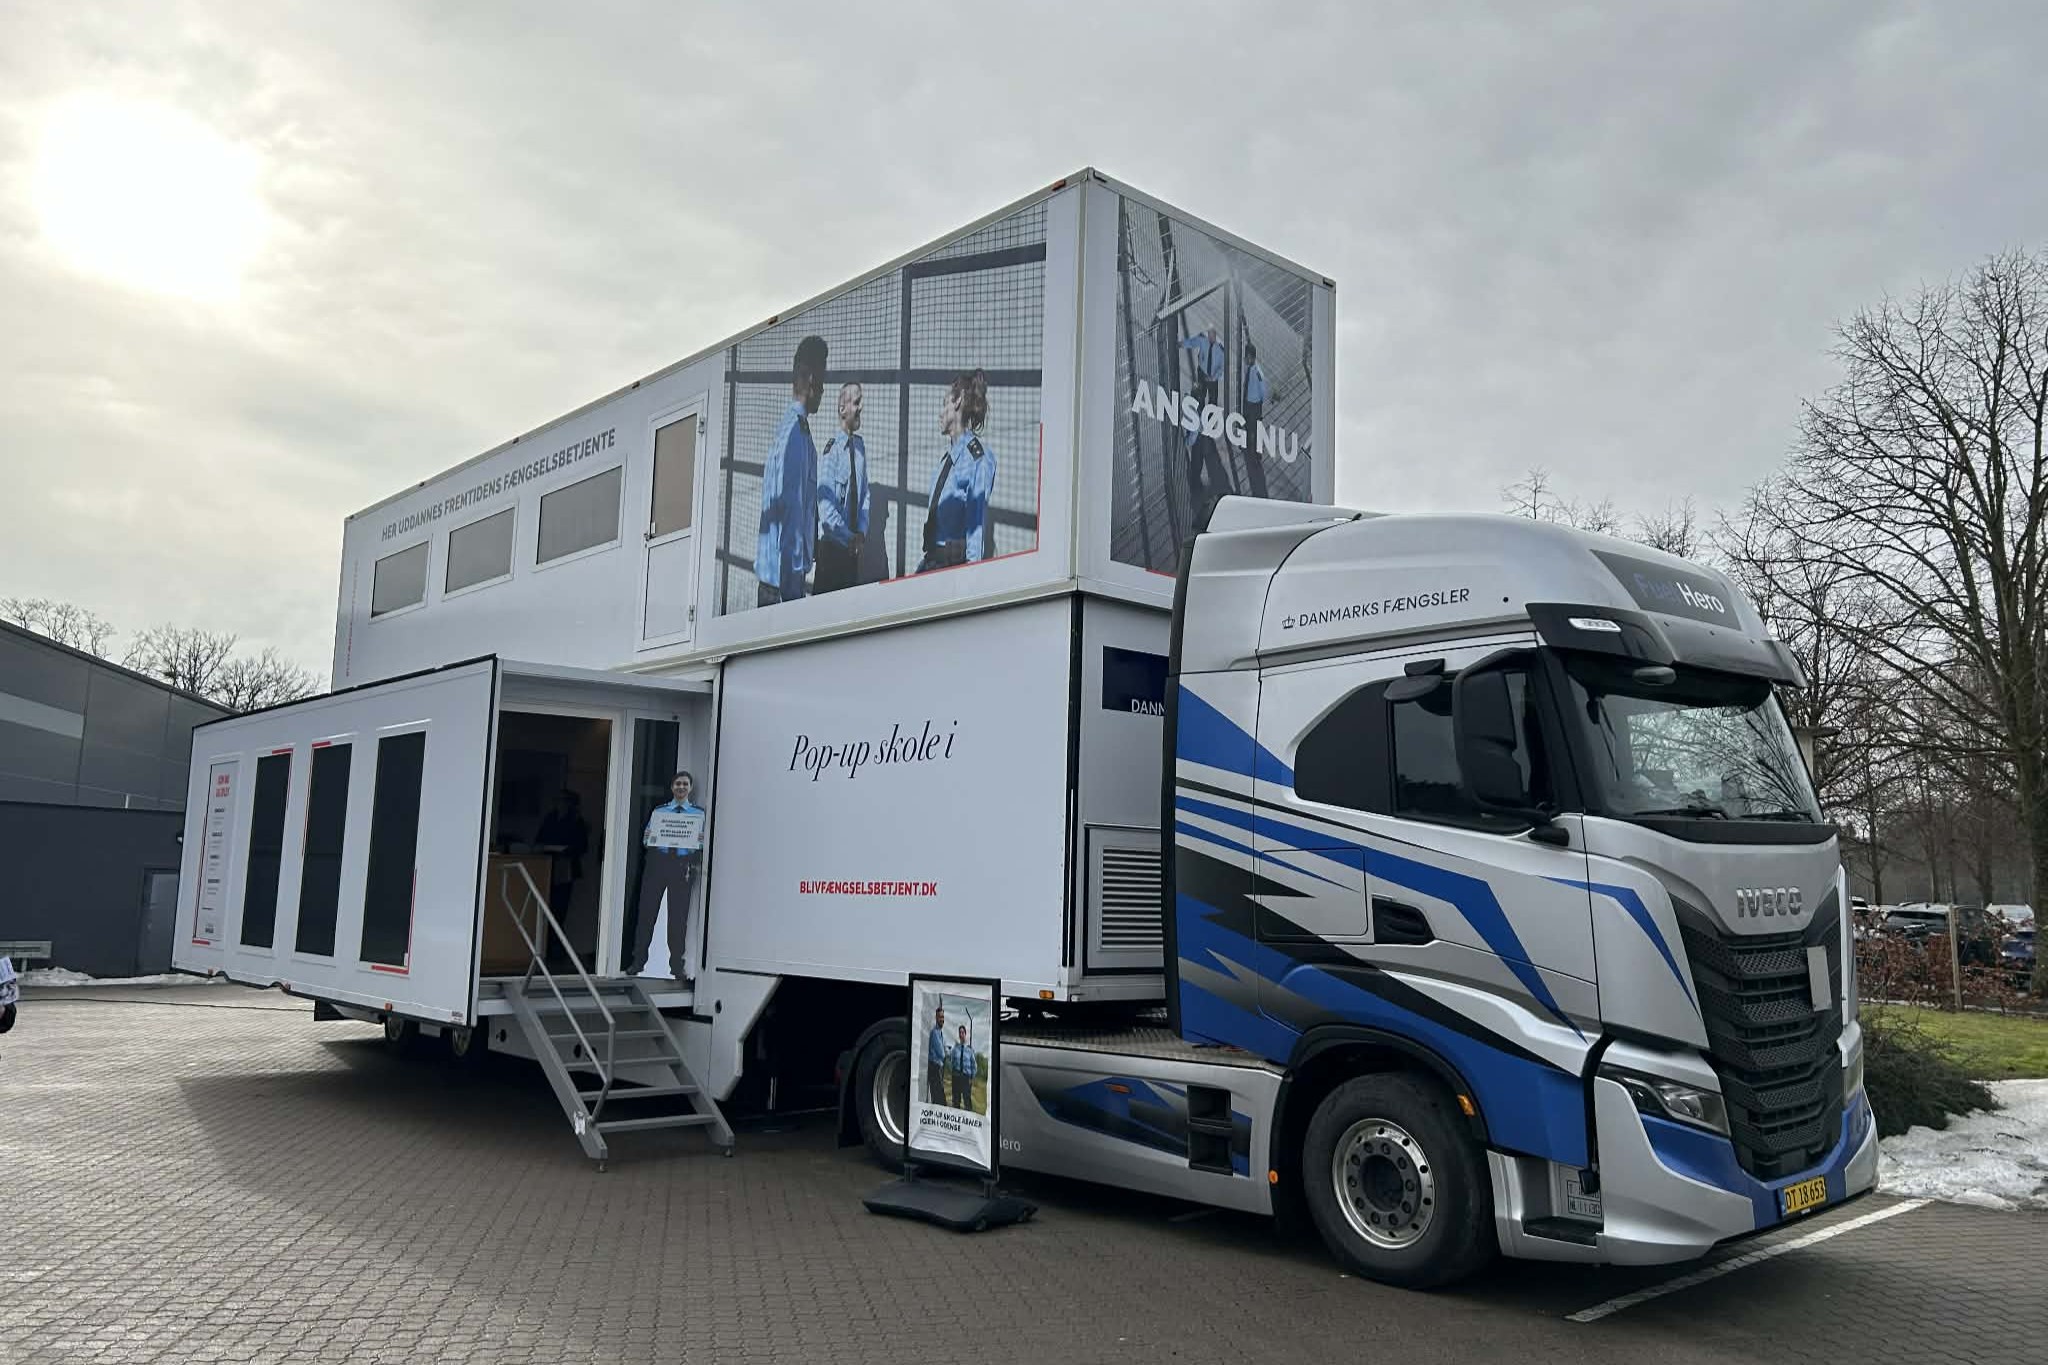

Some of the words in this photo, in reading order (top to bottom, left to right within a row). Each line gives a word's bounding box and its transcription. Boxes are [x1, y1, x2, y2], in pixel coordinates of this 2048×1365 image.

[1131, 379, 1248, 450] ANSØG
[1256, 419, 1299, 463] NU
[381, 522, 397, 542] HER
[398, 503, 443, 534] UDDANNES
[444, 477, 502, 516] FREMTIDENS
[503, 428, 616, 492] FÆNGSELSBETJENTE
[1299, 602, 1379, 627] DANMARKS
[1383, 588, 1470, 614] FÆNGSLER
[787, 734, 870, 782] Pop-up
[874, 719, 941, 765] skole
[944, 719, 958, 759] i
[799, 880, 938, 897] BLIVFÆNGSELSBETJENT.DK
[1736, 886, 1802, 918] IVECO
[1785, 1188, 1798, 1210] DT
[1799, 1185, 1809, 1206] 18
[1809, 1180, 1825, 1201] 653
